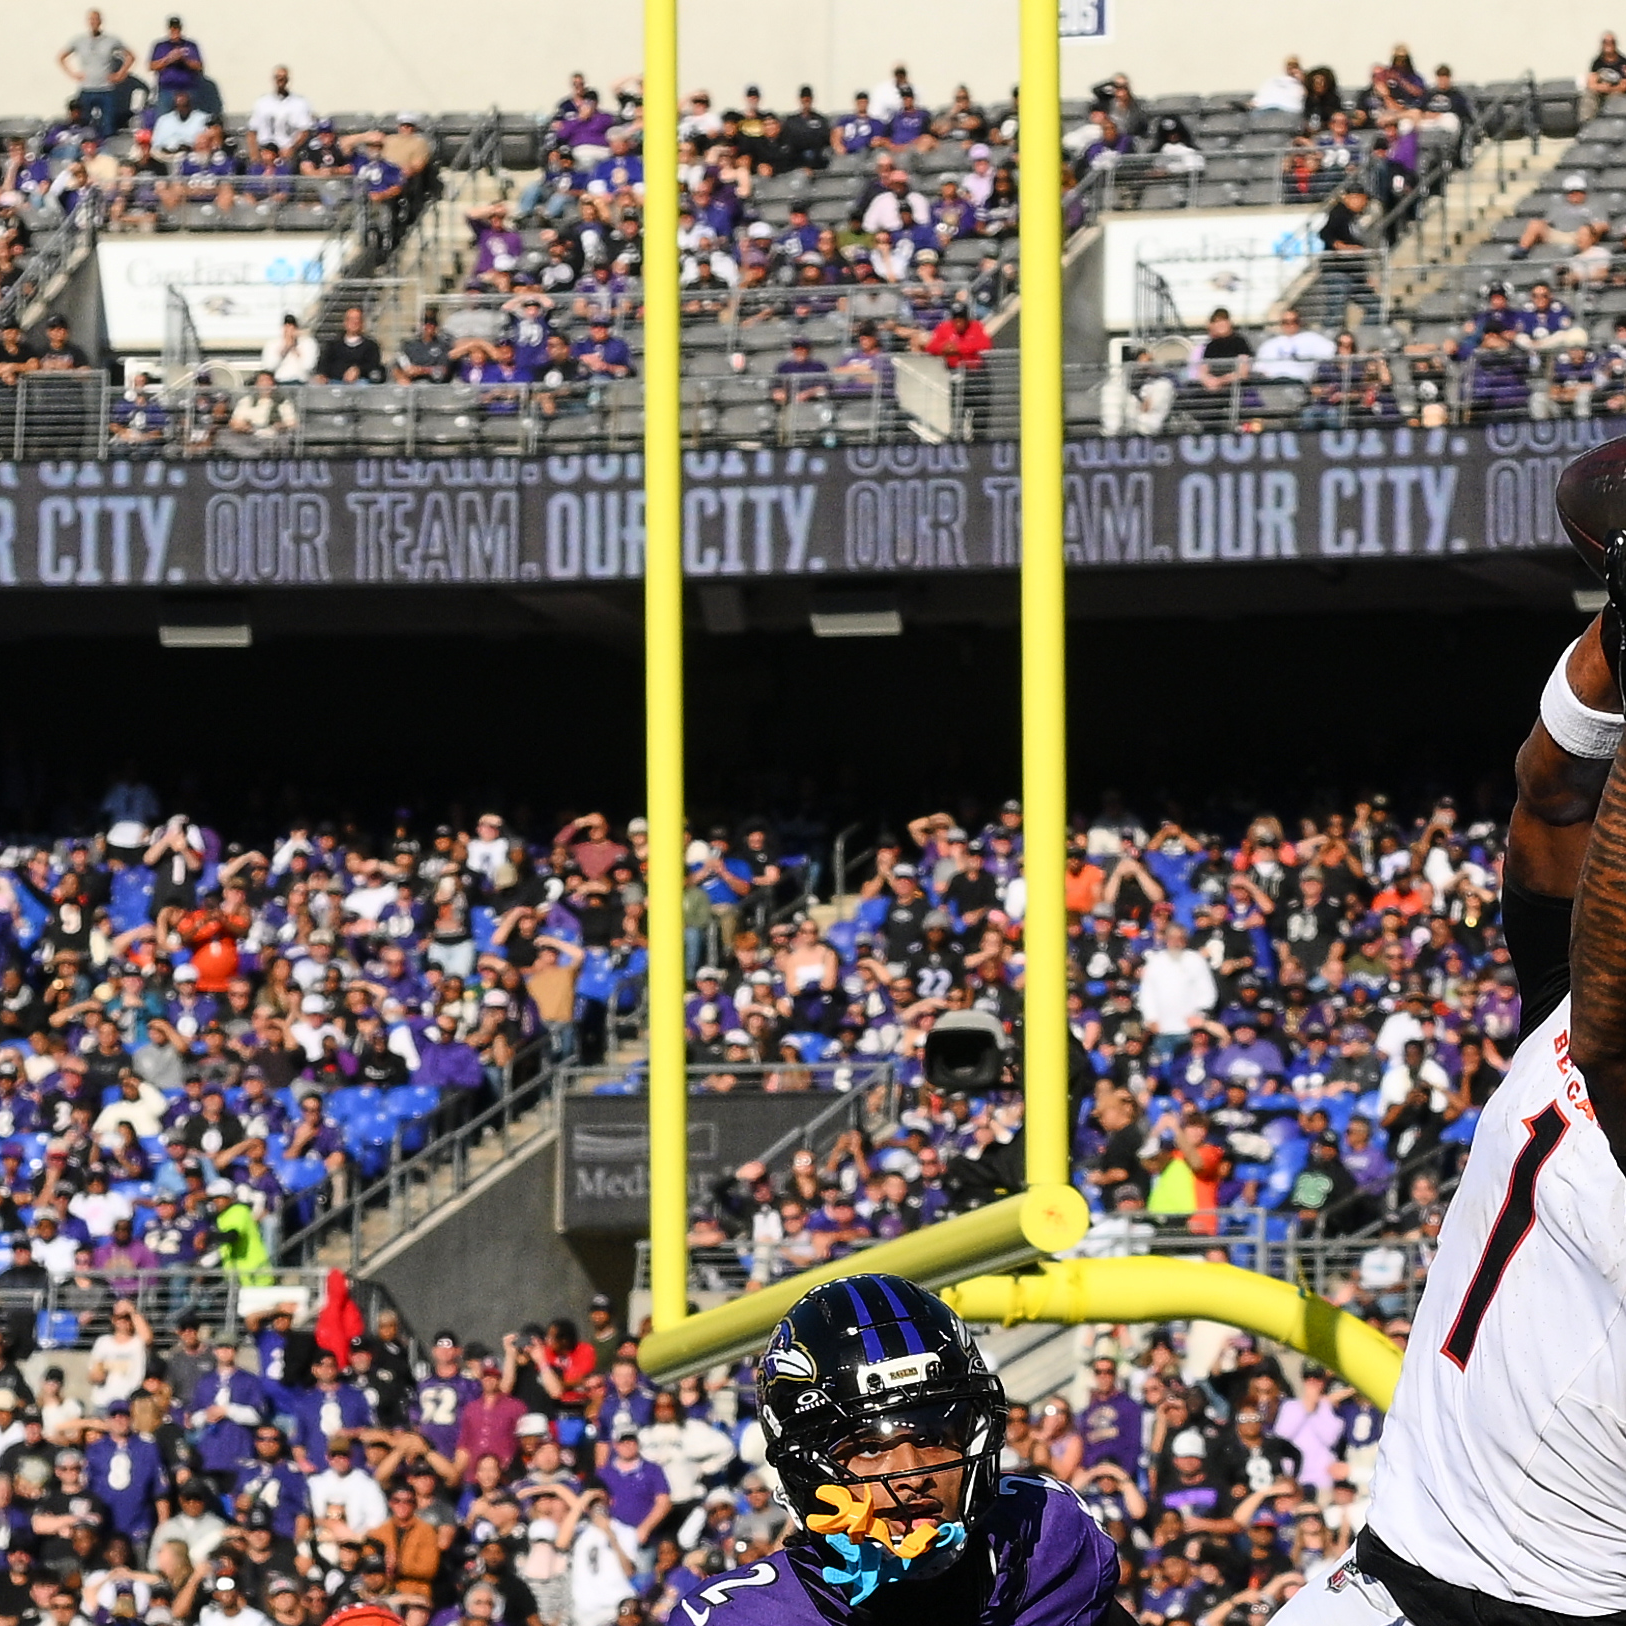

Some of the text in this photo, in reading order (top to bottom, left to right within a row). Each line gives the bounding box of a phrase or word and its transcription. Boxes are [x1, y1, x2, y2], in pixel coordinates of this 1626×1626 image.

[36, 494, 185, 584] CITY.
[203, 492, 331, 584] OUR
[347, 489, 541, 583] TEAM.
[684, 484, 827, 576] CITY.
[846, 478, 967, 571] OUR
[985, 471, 1173, 566] TAM.
[1179, 467, 1302, 561] OUR
[1332, 463, 1468, 557] CITY.
[1486, 457, 1561, 549] OU
[1440, 1099, 1571, 1373] 1
[794, 1399, 826, 1414] OAKLEY
[107, 1451, 133, 1490] 8
